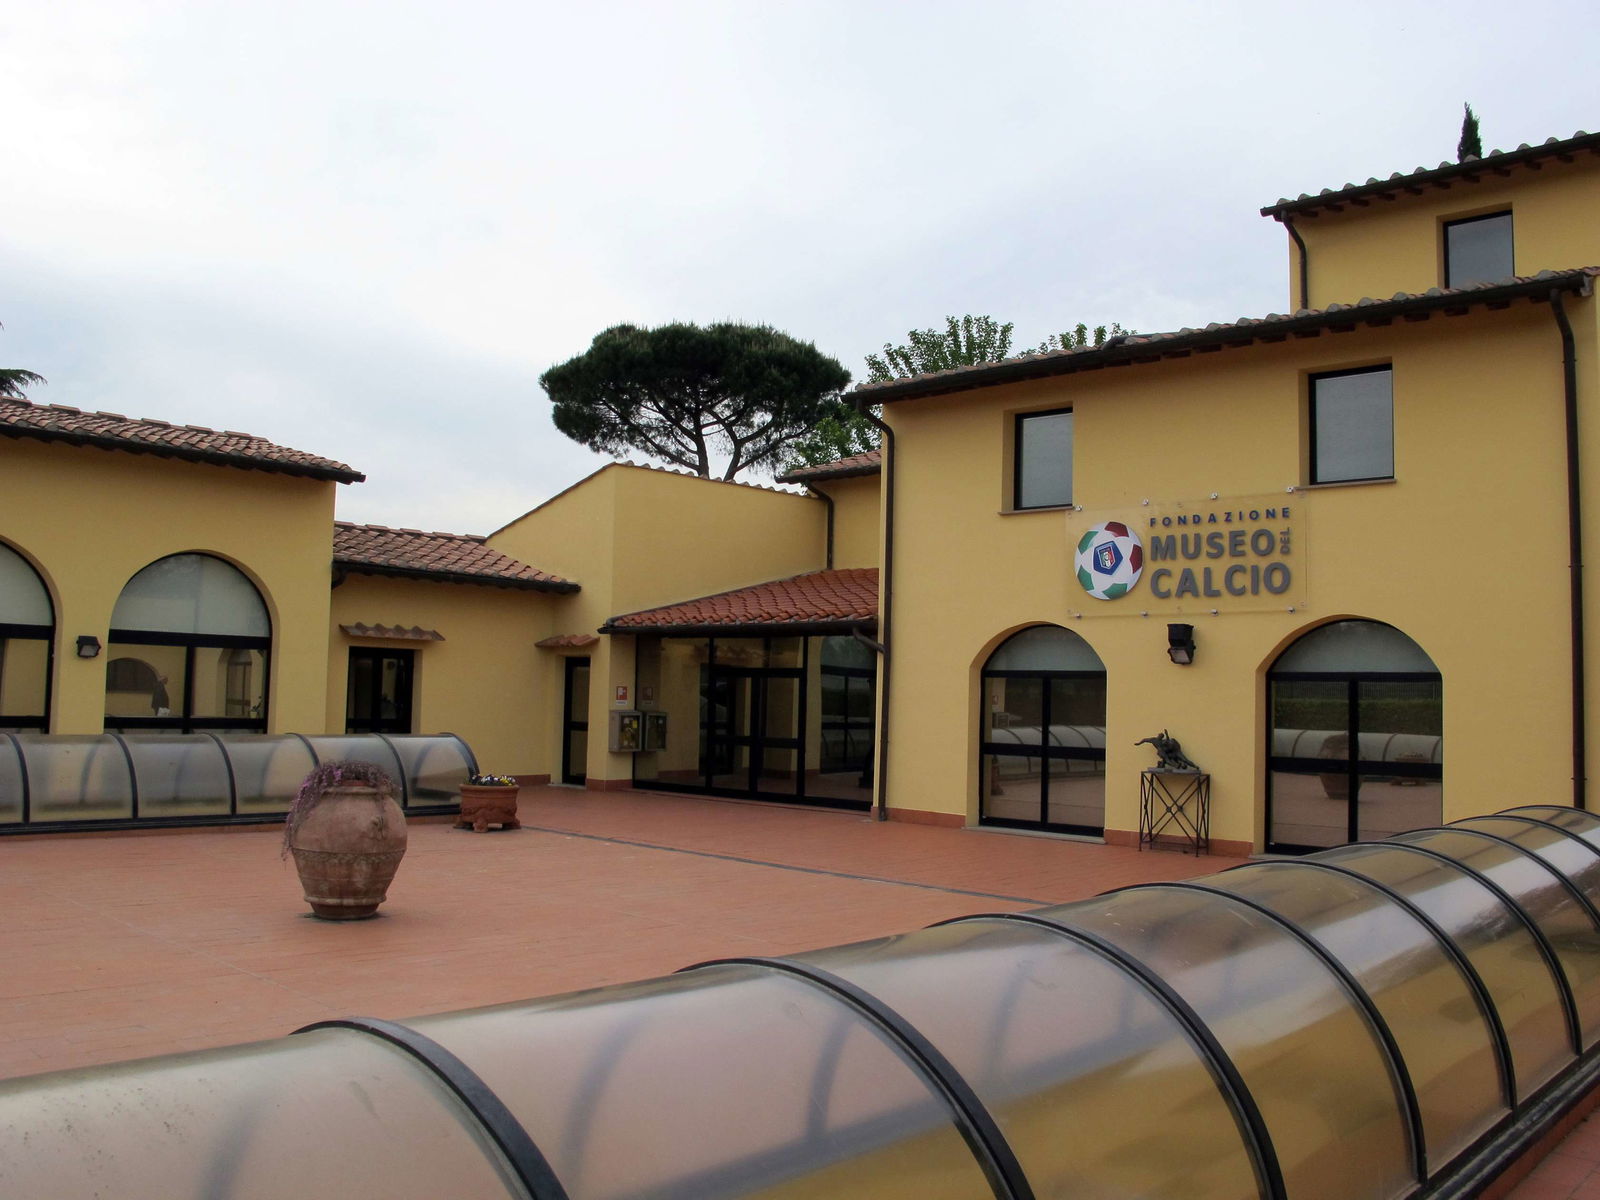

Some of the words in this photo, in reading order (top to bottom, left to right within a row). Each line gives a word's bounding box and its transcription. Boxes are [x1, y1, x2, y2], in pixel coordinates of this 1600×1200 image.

[1150, 507, 1290, 527] FONDAZIONE
[1151, 529, 1275, 561] MUSEO
[1280, 527, 1290, 554] DEL
[1150, 562, 1291, 598] CALCIO
